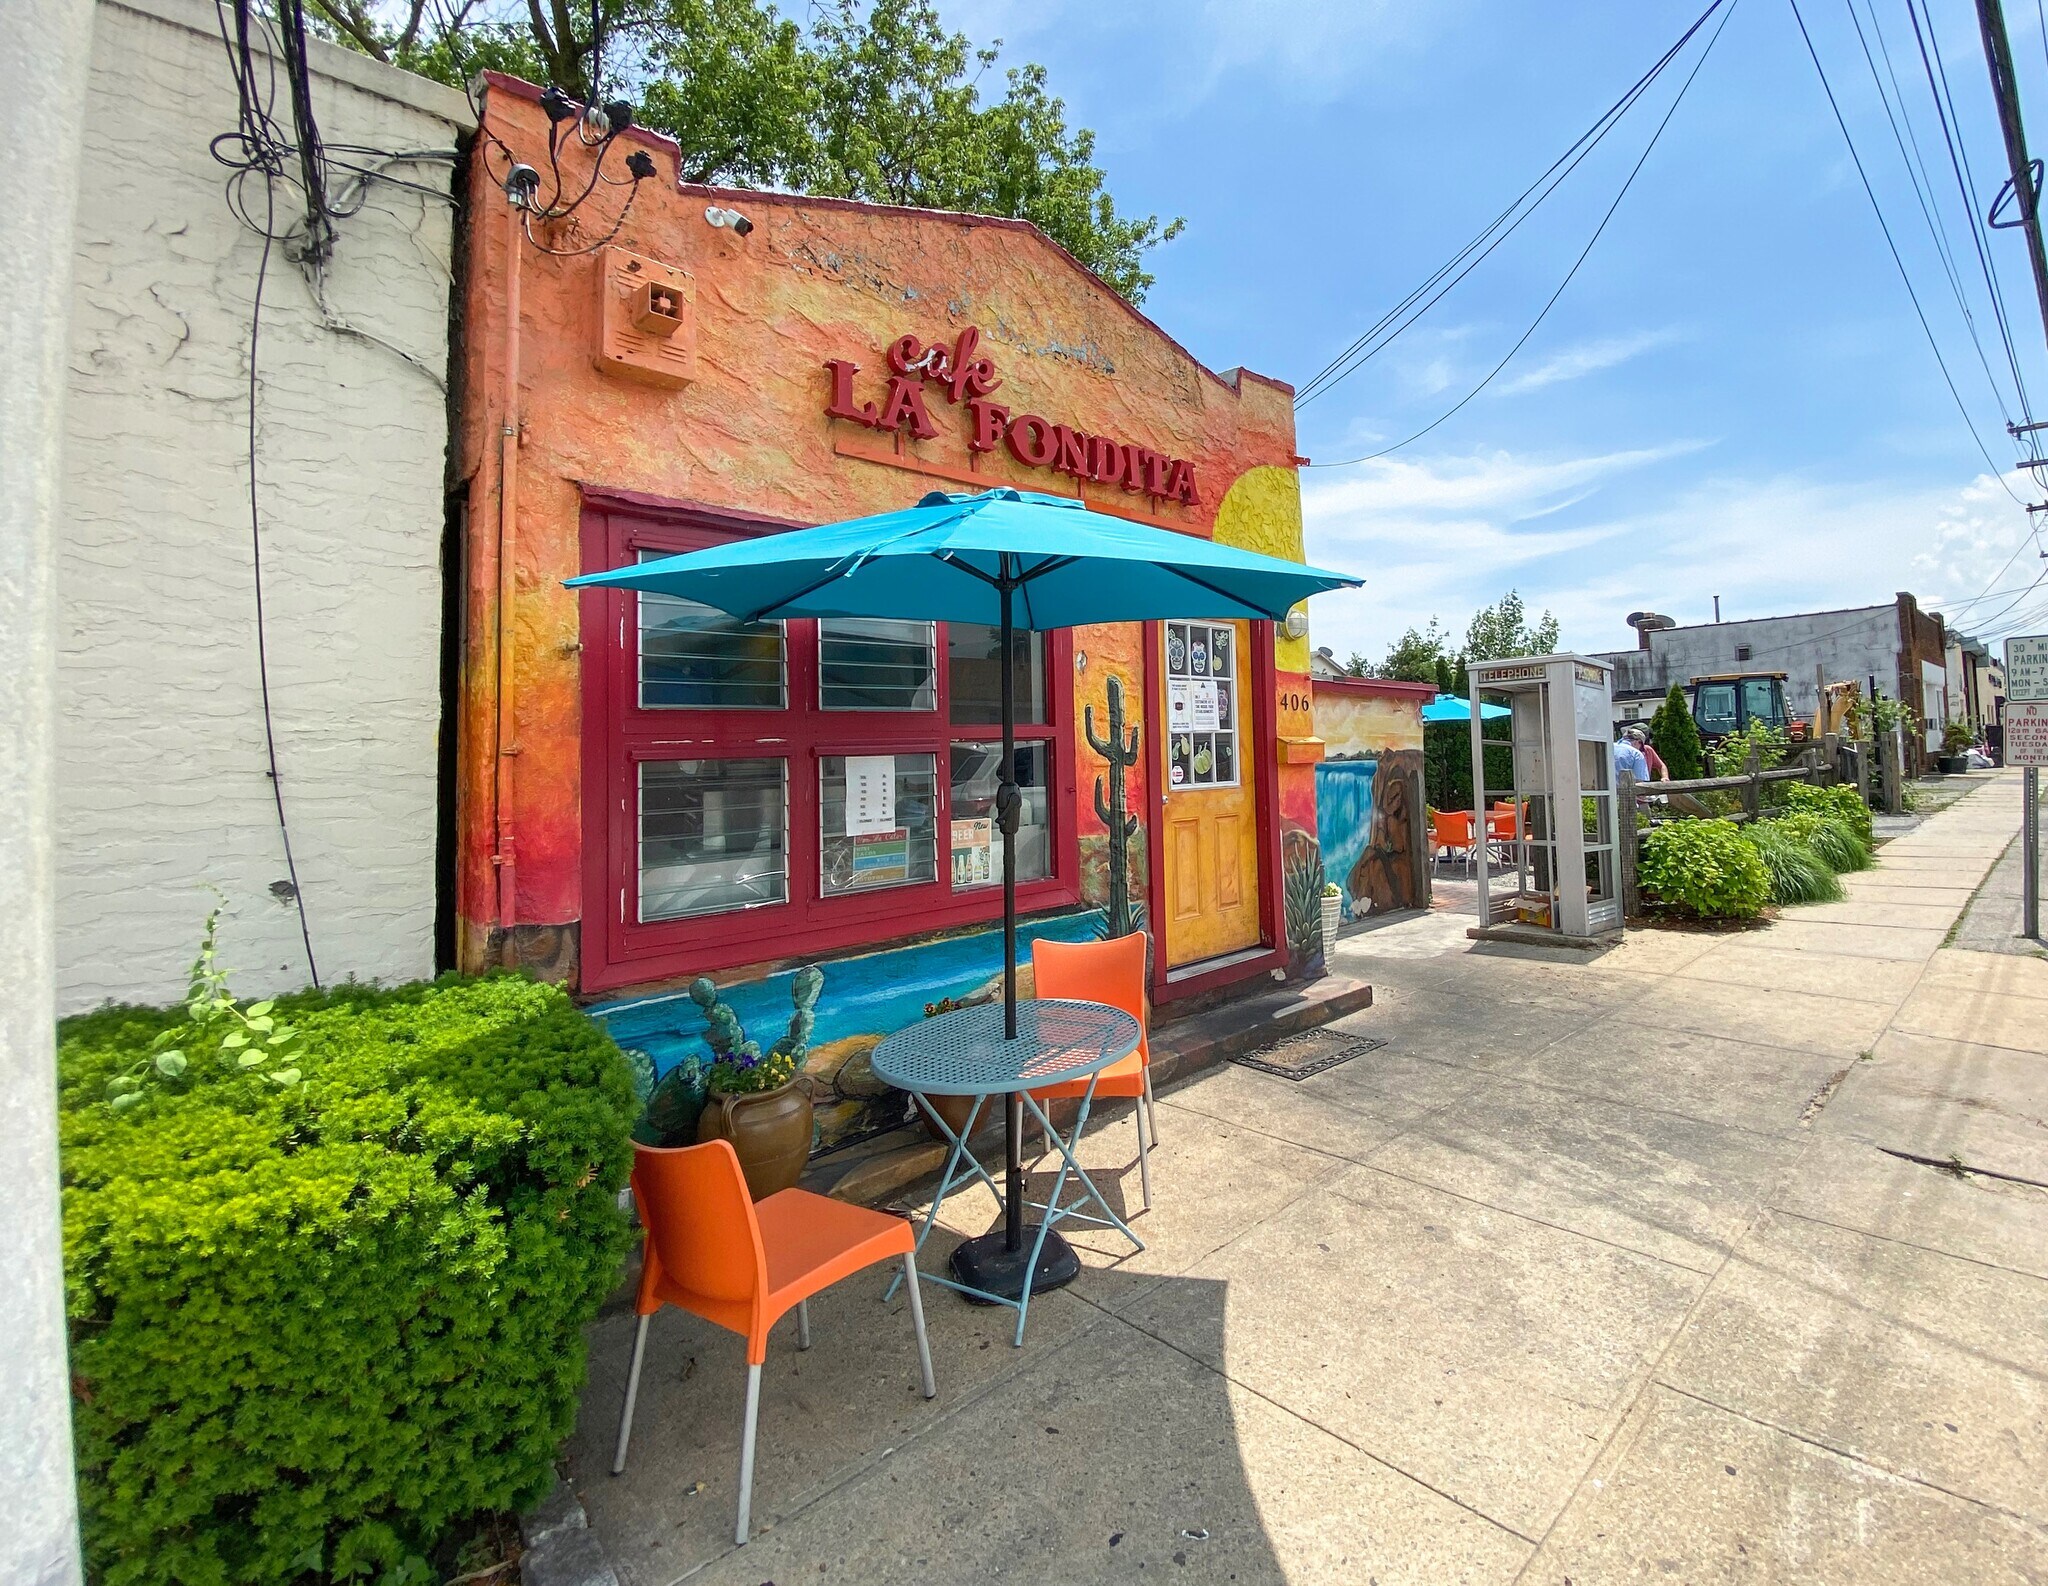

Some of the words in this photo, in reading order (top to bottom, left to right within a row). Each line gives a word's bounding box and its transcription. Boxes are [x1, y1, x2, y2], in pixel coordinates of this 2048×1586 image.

[886, 325, 1003, 405] cafe
[822, 358, 940, 440] LA
[964, 398, 1202, 508] FONDITA
[2013, 644, 2024, 653] 30
[1479, 666, 1545, 682] TELEPHONE
[2011, 668, 2017, 677] 9
[2011, 679, 2031, 687] MON
[1280, 693, 1309, 711] 406
[2026, 706, 2037, 715] NO
[973, 821, 989, 831] New
